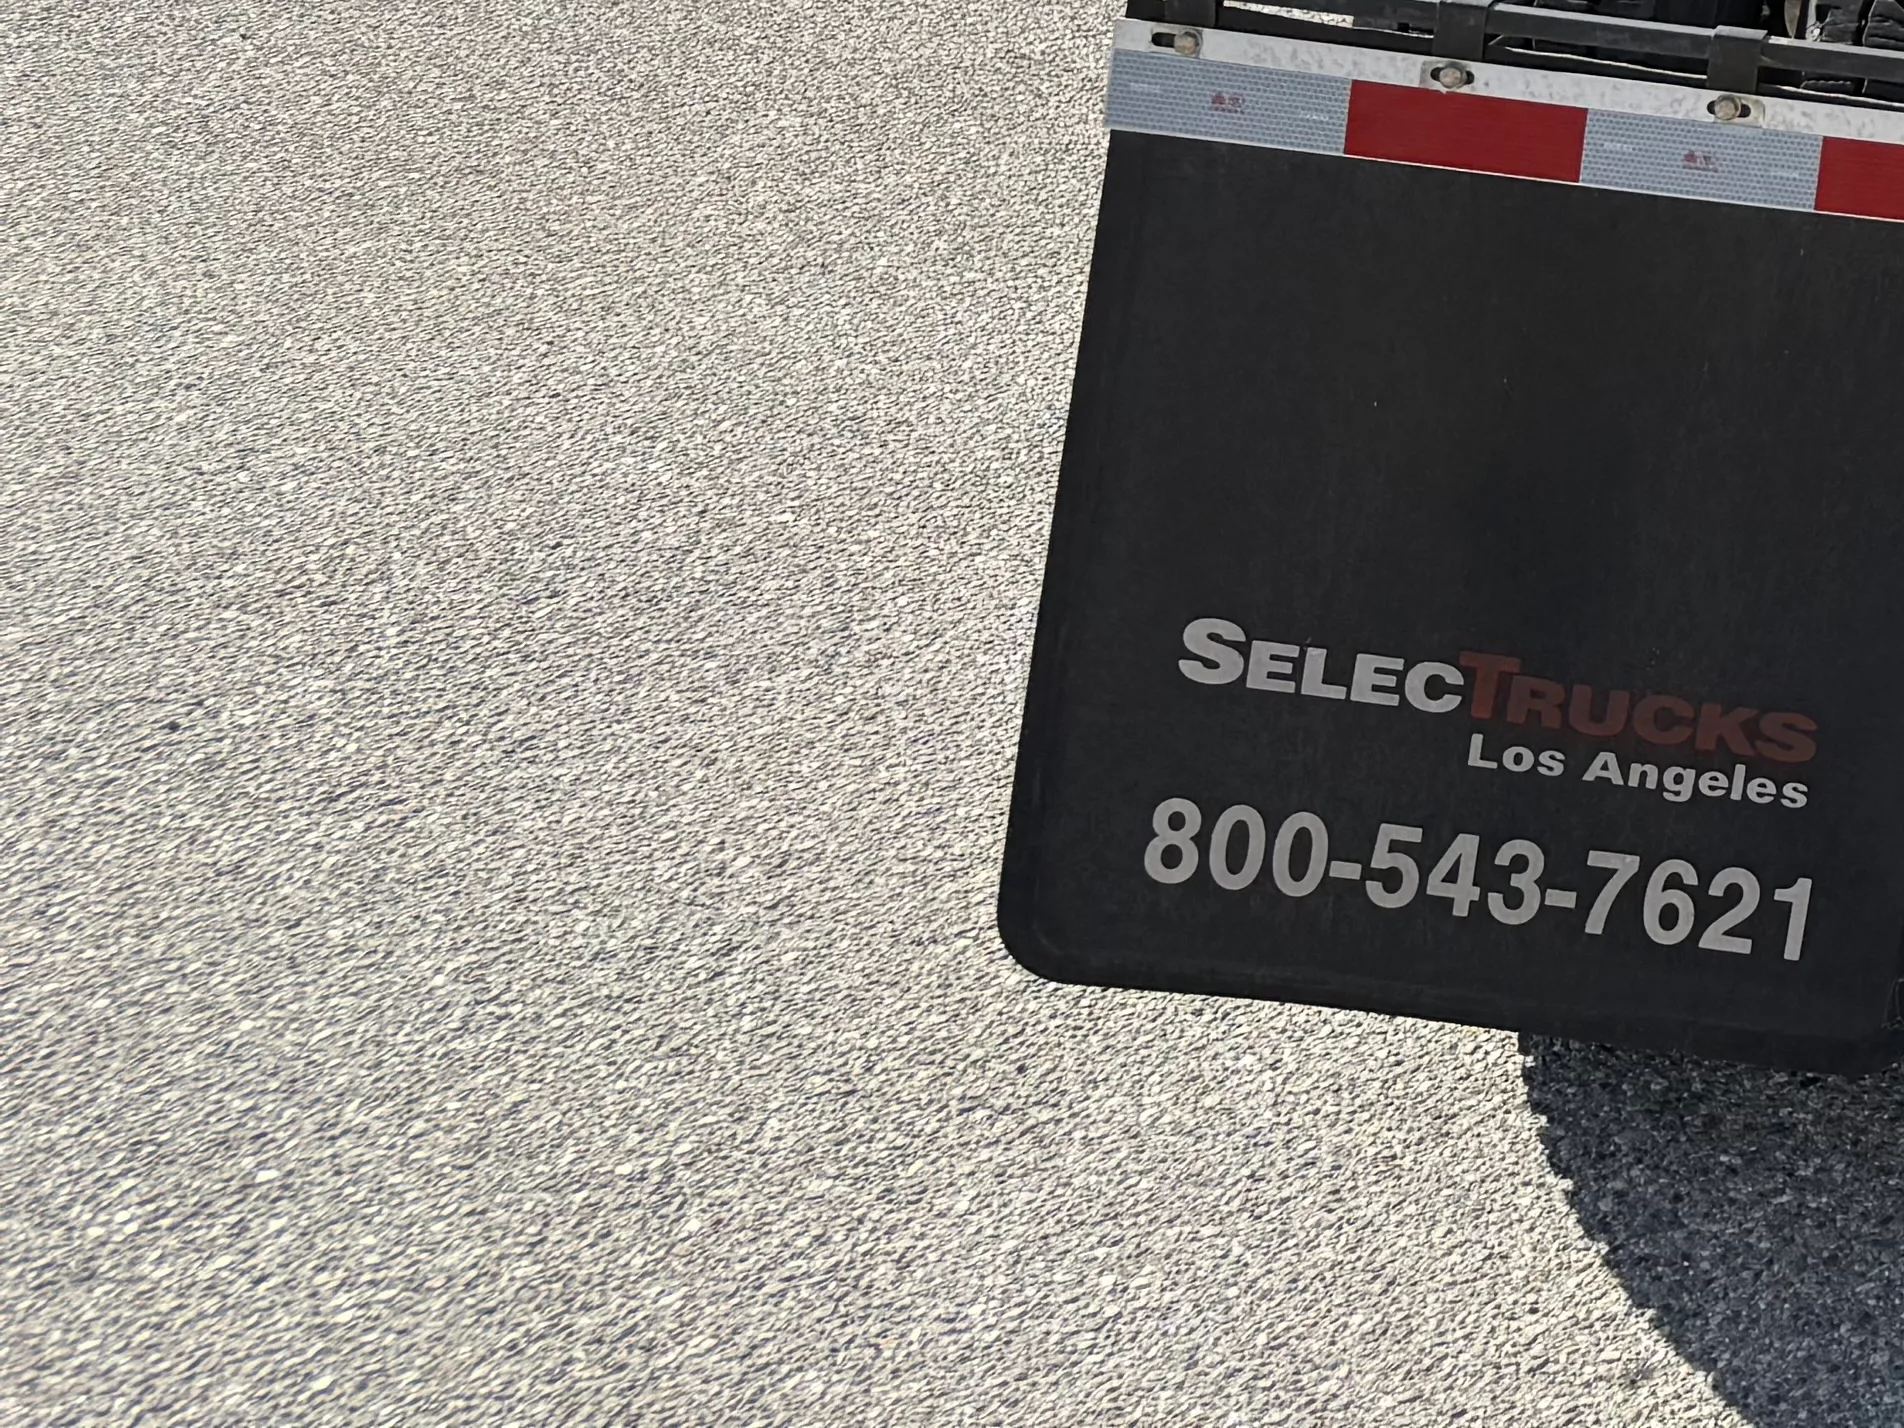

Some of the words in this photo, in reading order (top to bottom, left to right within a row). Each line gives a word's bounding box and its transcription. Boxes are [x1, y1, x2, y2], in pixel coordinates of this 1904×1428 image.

[1177, 616, 1818, 764] SELECTRUCKS
[1467, 732, 1565, 777] Los
[1581, 750, 1810, 809] Angeles
[1142, 796, 1813, 962] 800-543-7621
